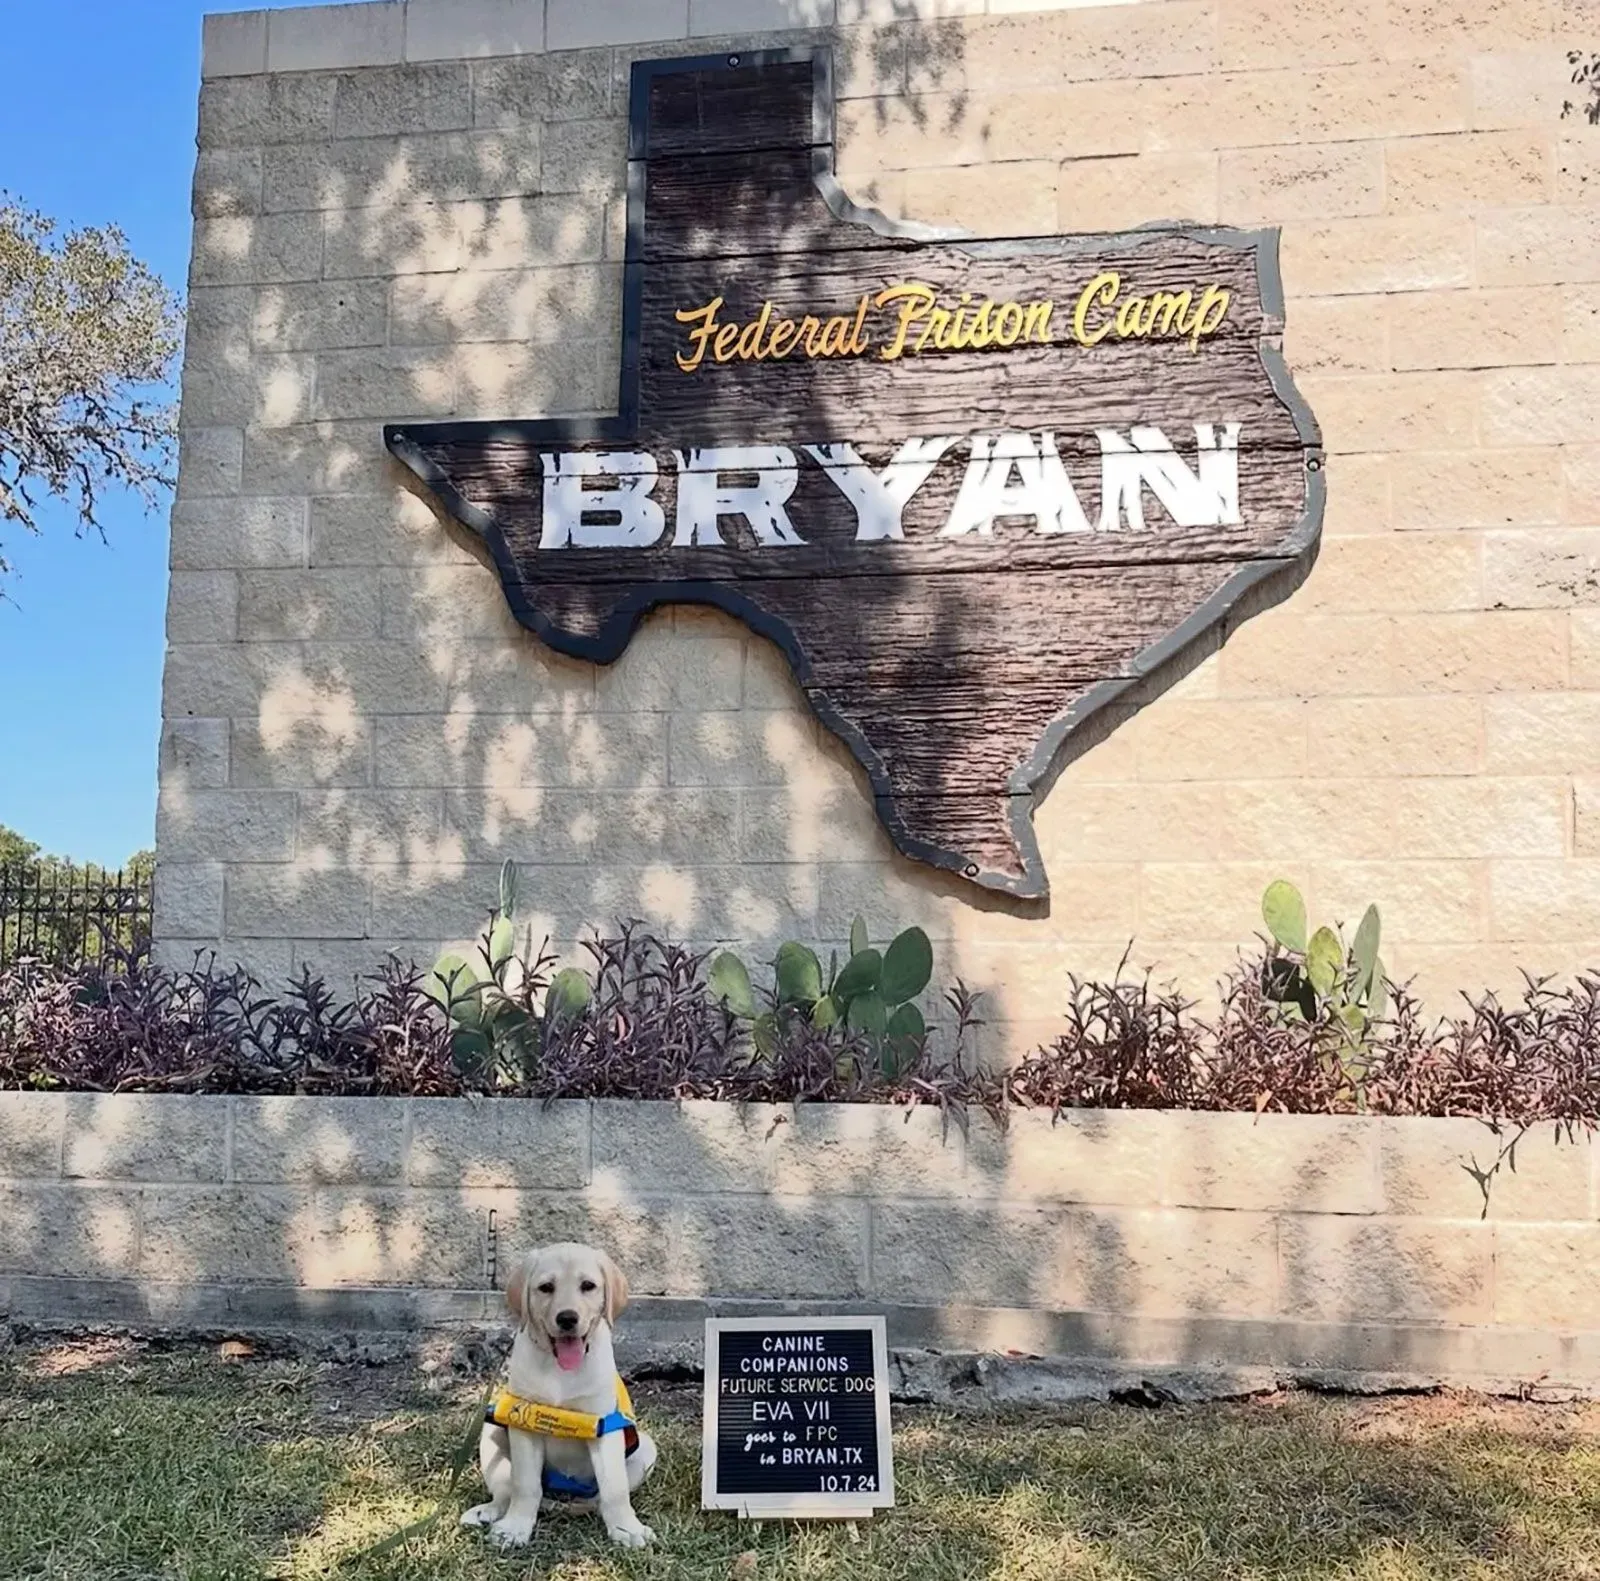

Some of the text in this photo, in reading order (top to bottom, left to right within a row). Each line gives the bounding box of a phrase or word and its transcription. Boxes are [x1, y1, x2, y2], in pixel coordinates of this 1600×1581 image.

[675, 272, 1230, 373] Federal Prison Camp
[538, 422, 1242, 550] BRYAN
[762, 1336, 825, 1352] CANINE
[740, 1357, 849, 1372] COMPANIONS
[721, 1377, 875, 1394] FUTURE SERVICE DOG
[752, 1400, 830, 1421] EVA VII
[745, 1426, 838, 1451] goes to FPC
[760, 1453, 776, 1465] in
[820, 1475, 876, 1492] 10.7.24
